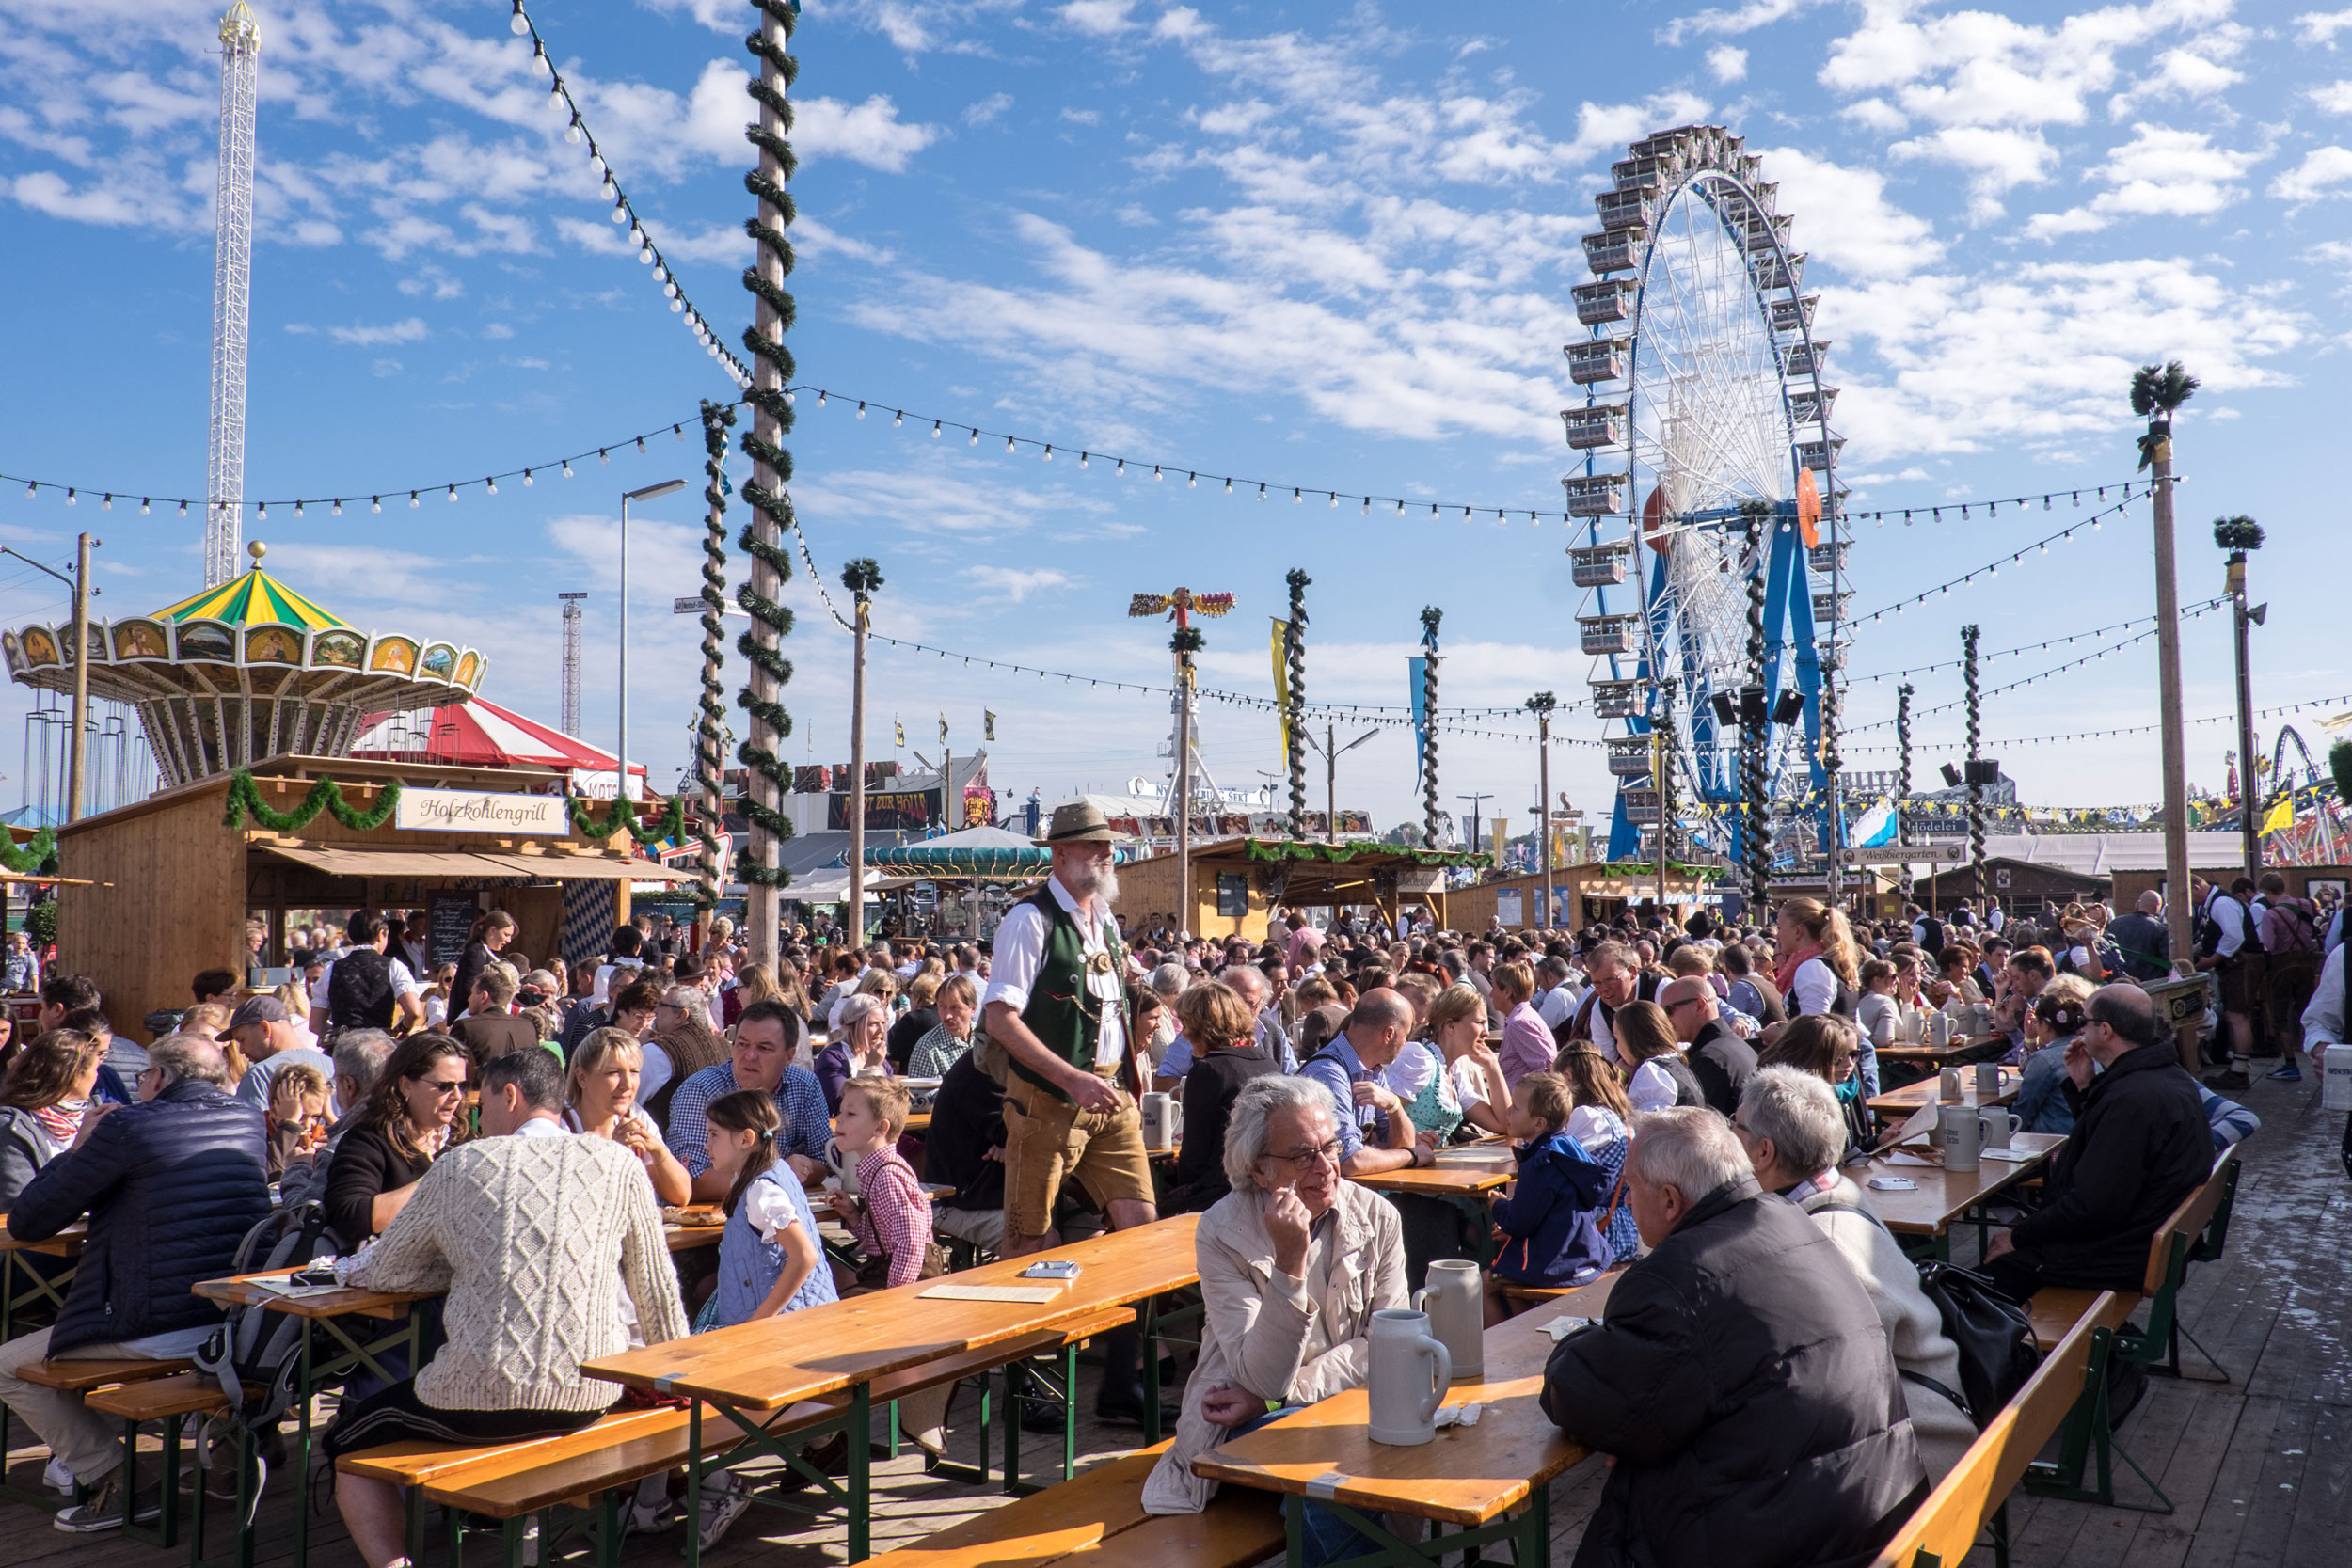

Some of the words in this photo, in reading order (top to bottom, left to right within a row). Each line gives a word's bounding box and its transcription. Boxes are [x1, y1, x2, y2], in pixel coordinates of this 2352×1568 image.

[876, 796, 895, 810] ZUR
[421, 799, 548, 826] Holzkohlengrill
[1911, 821, 1956, 832] nödelei
[1862, 848, 1941, 862] Weißbiergarten
